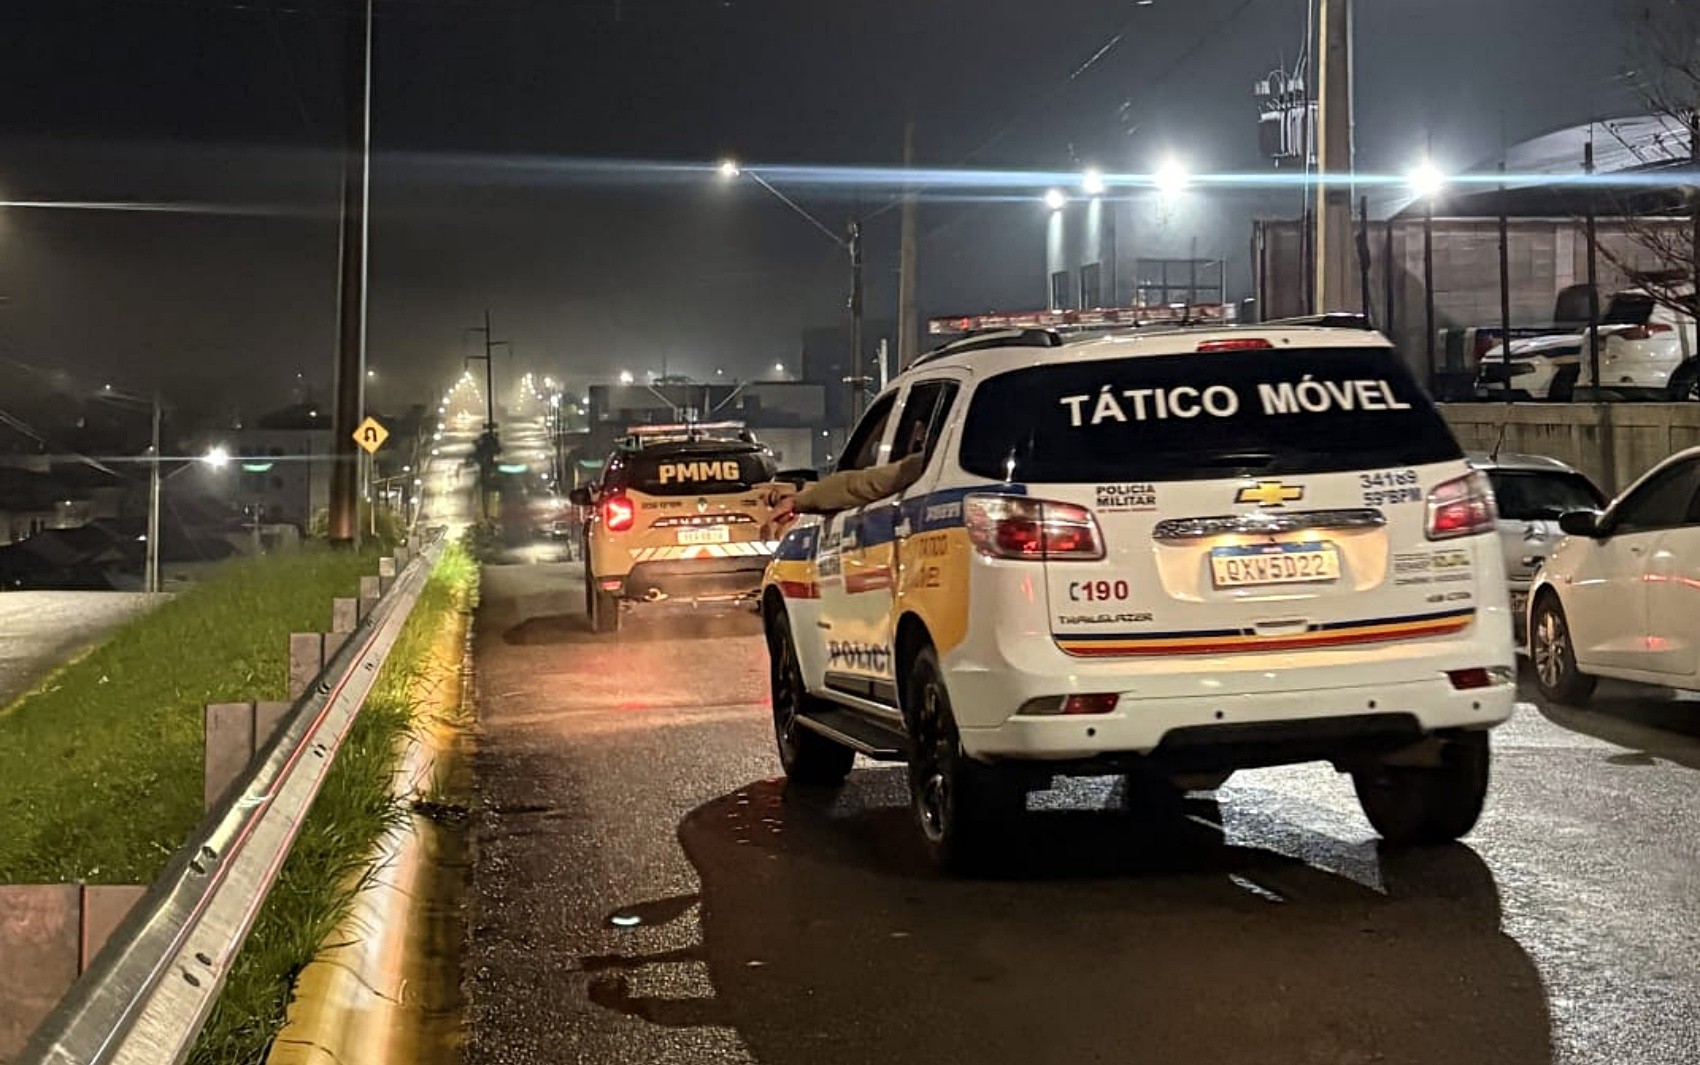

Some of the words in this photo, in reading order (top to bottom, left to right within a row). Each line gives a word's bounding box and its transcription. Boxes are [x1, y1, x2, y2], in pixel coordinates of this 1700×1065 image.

[1060, 384, 1240, 427] TÁTICO
[1257, 374, 1412, 416] MÓVEL
[659, 461, 740, 485] PMMG
[1096, 496, 1156, 507] MILITAR
[1081, 580, 1129, 601] 190
